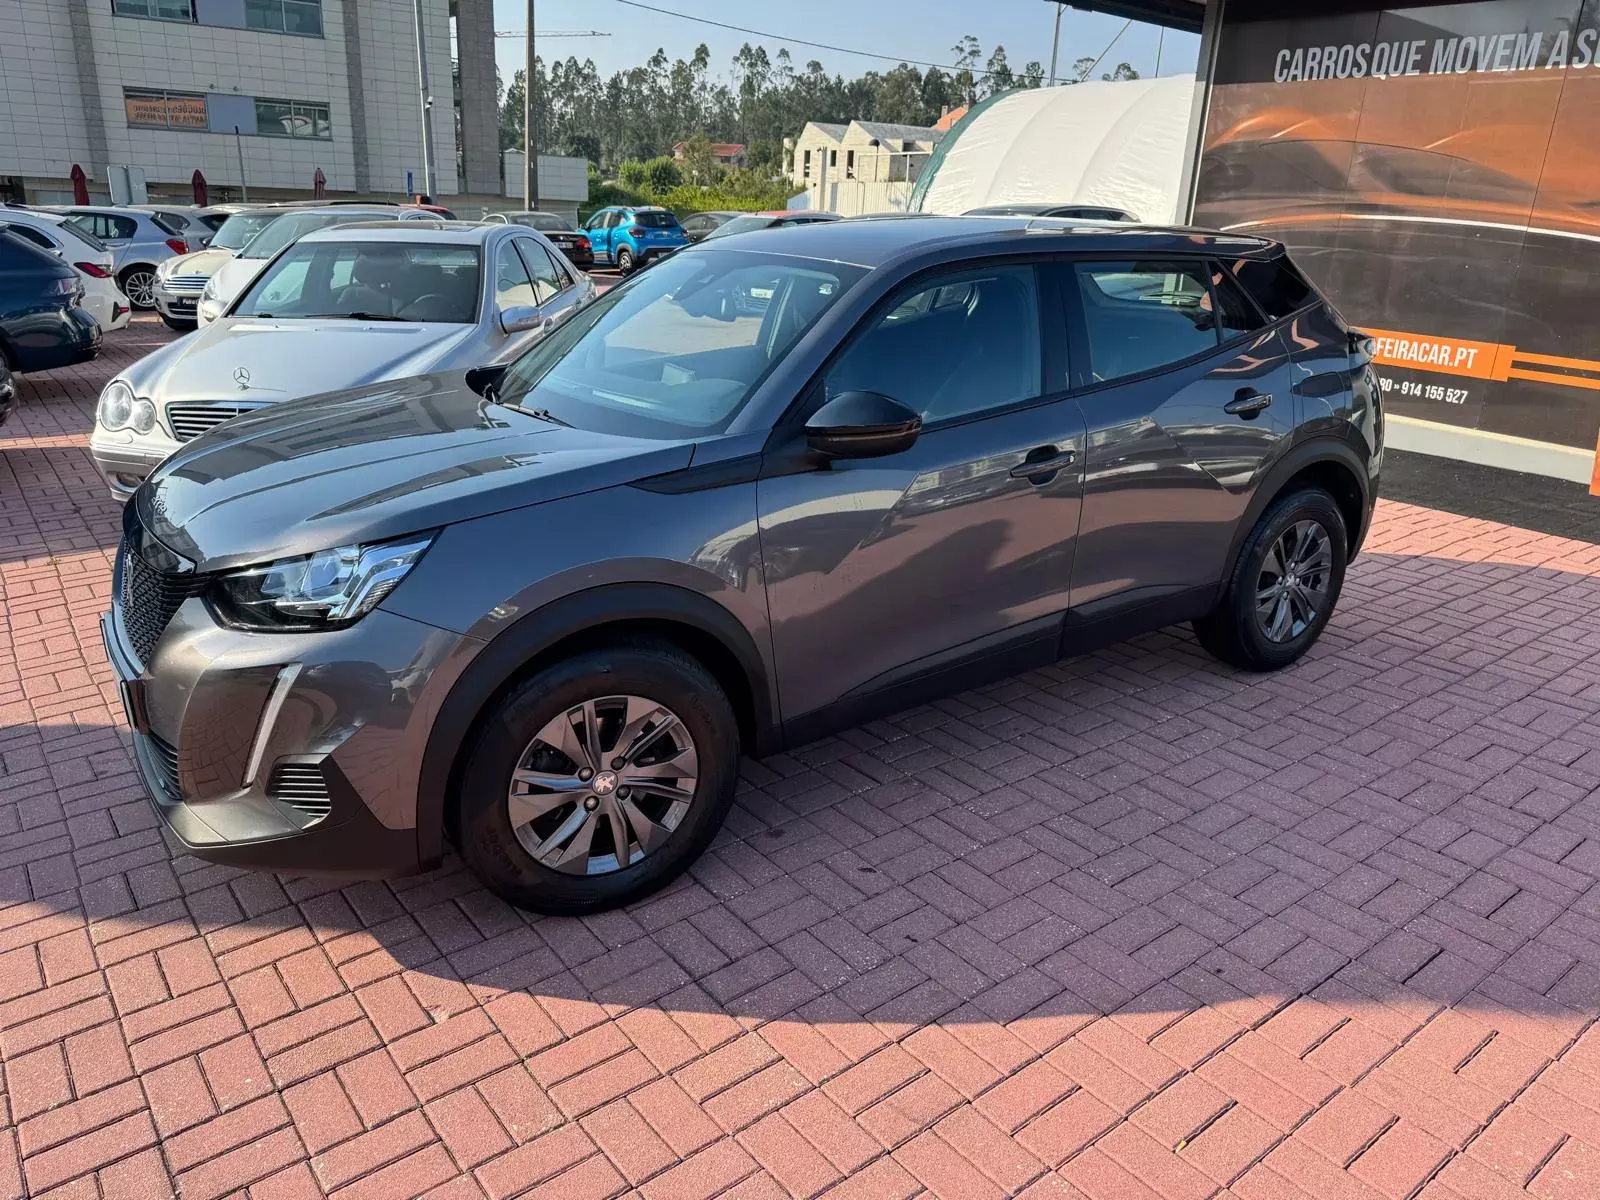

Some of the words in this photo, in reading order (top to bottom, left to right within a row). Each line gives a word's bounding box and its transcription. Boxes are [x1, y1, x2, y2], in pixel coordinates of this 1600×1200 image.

[1274, 43, 1370, 83] CARROS
[1371, 40, 1426, 80] QUE
[1429, 32, 1543, 75] MOVEM
[1401, 381, 1422, 397] 914
[1425, 384, 1445, 401] 155
[1446, 388, 1468, 405] 527
